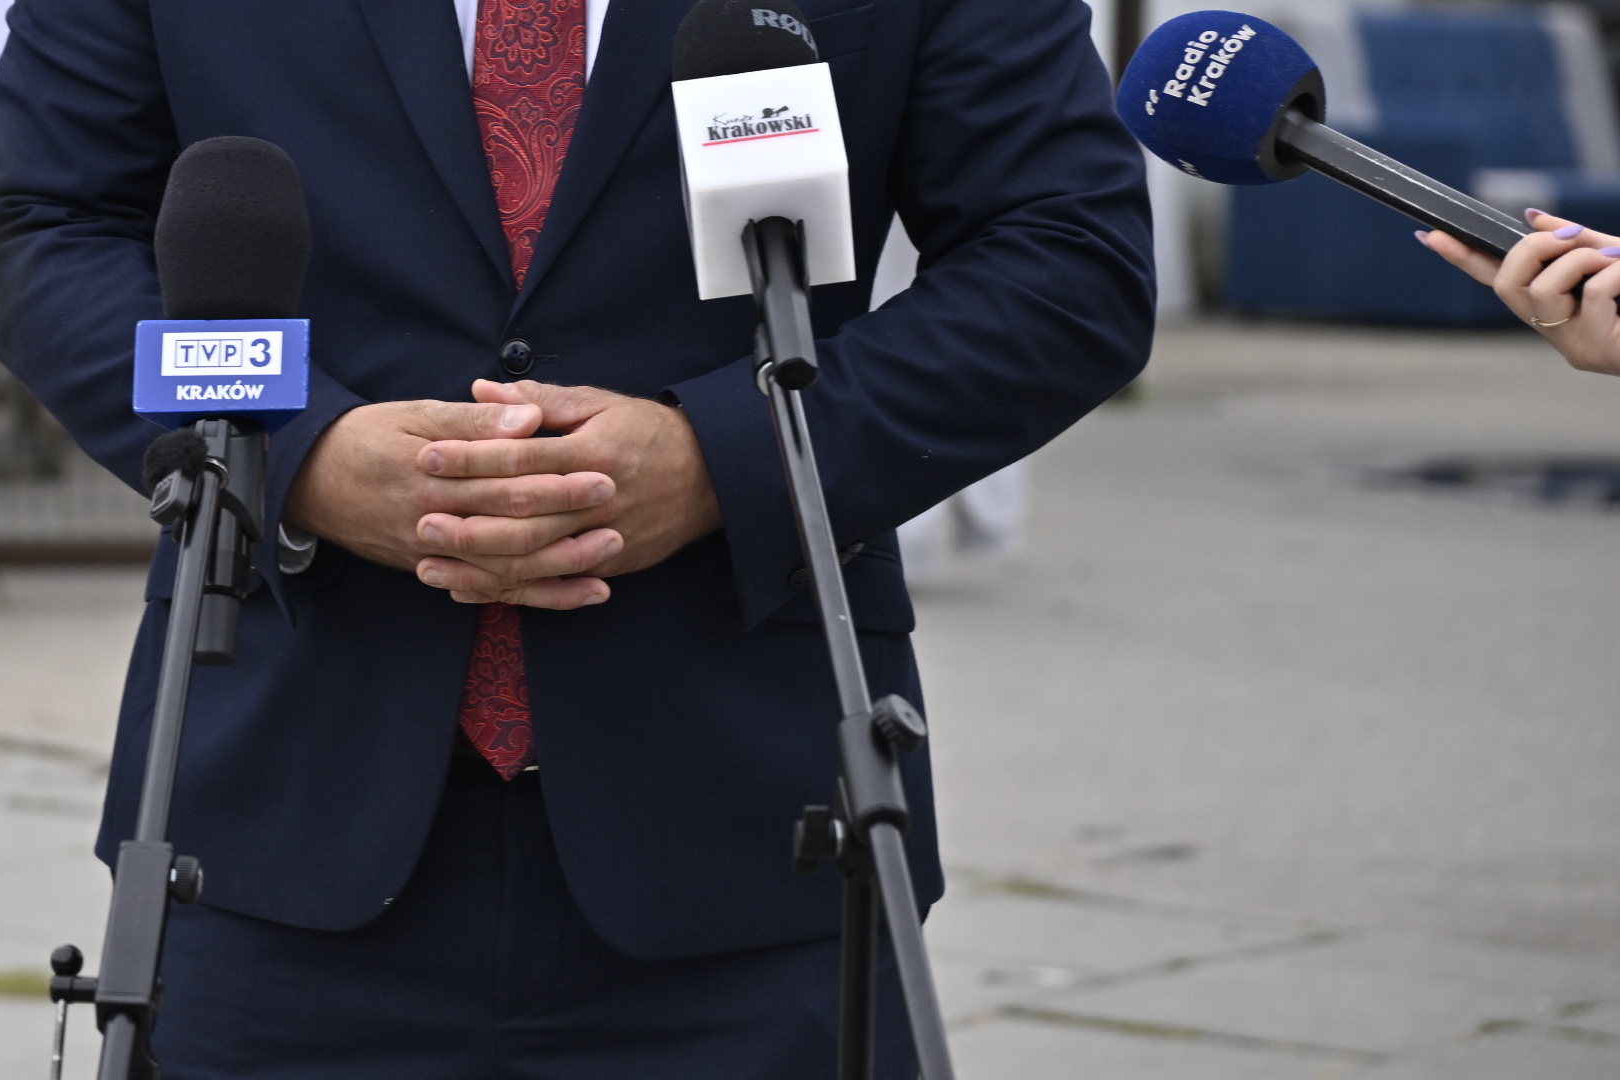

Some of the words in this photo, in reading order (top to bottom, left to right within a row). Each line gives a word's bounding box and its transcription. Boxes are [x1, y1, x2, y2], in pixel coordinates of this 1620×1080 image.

[751, 8, 819, 61] RØD
[1163, 30, 1219, 98] Radio
[1186, 24, 1257, 107] Kraków
[707, 114, 813, 141] Krakowski
[176, 380, 265, 400] KRAKÓW
